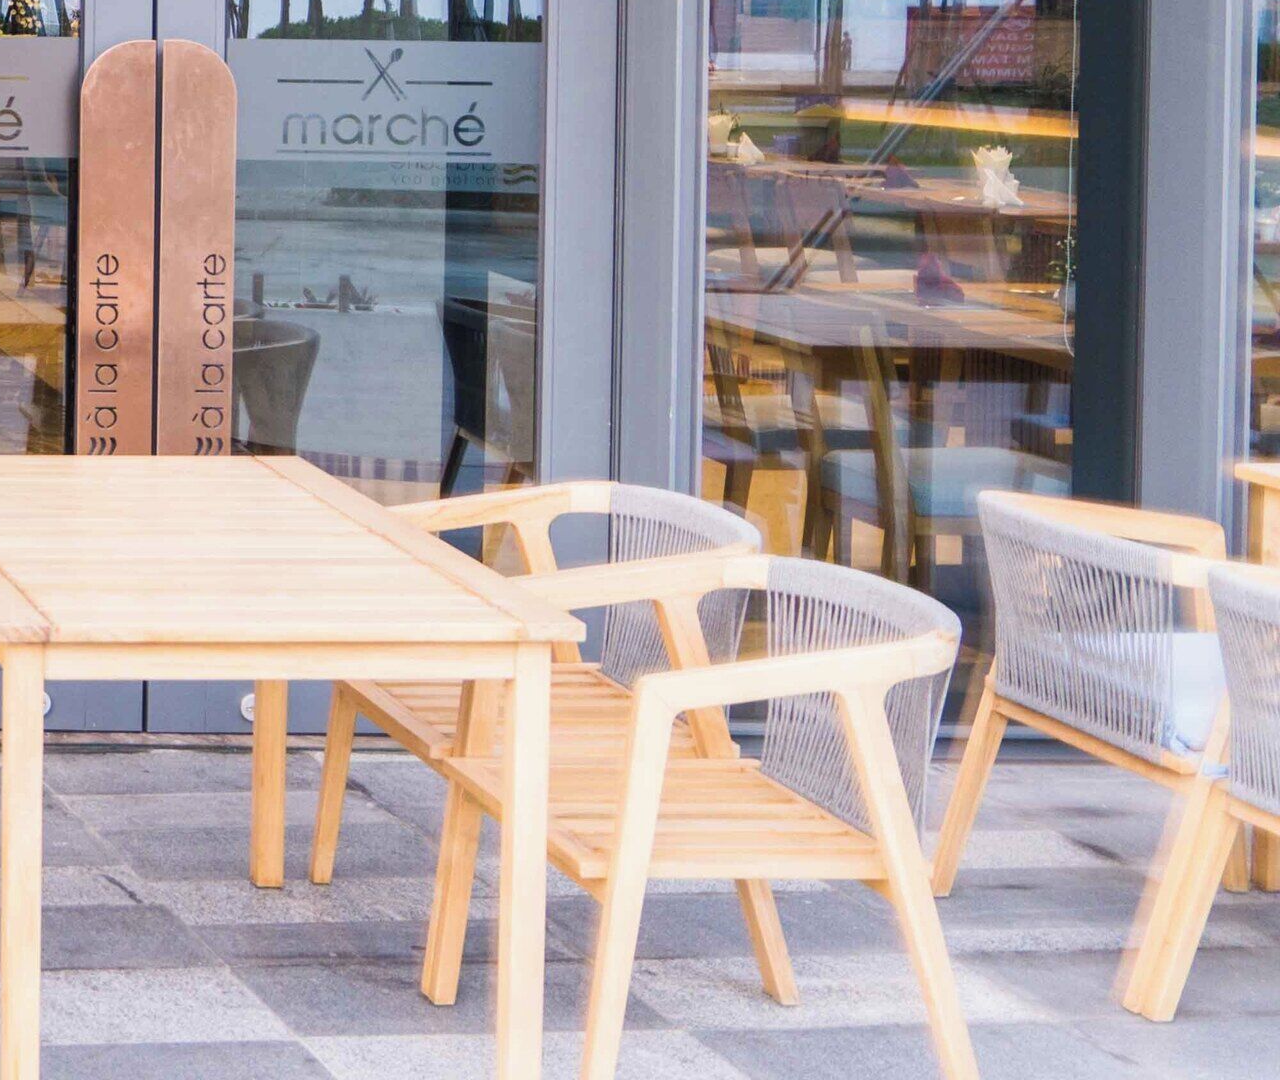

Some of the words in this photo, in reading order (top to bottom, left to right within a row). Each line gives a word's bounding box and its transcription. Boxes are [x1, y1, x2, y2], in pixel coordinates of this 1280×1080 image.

[282, 100, 486, 147] marché
[89, 253, 120, 350] carte
[196, 253, 227, 350] carte
[87, 363, 118, 393] la
[194, 363, 225, 393] la
[86, 406, 118, 429] à
[191, 406, 224, 429] à
